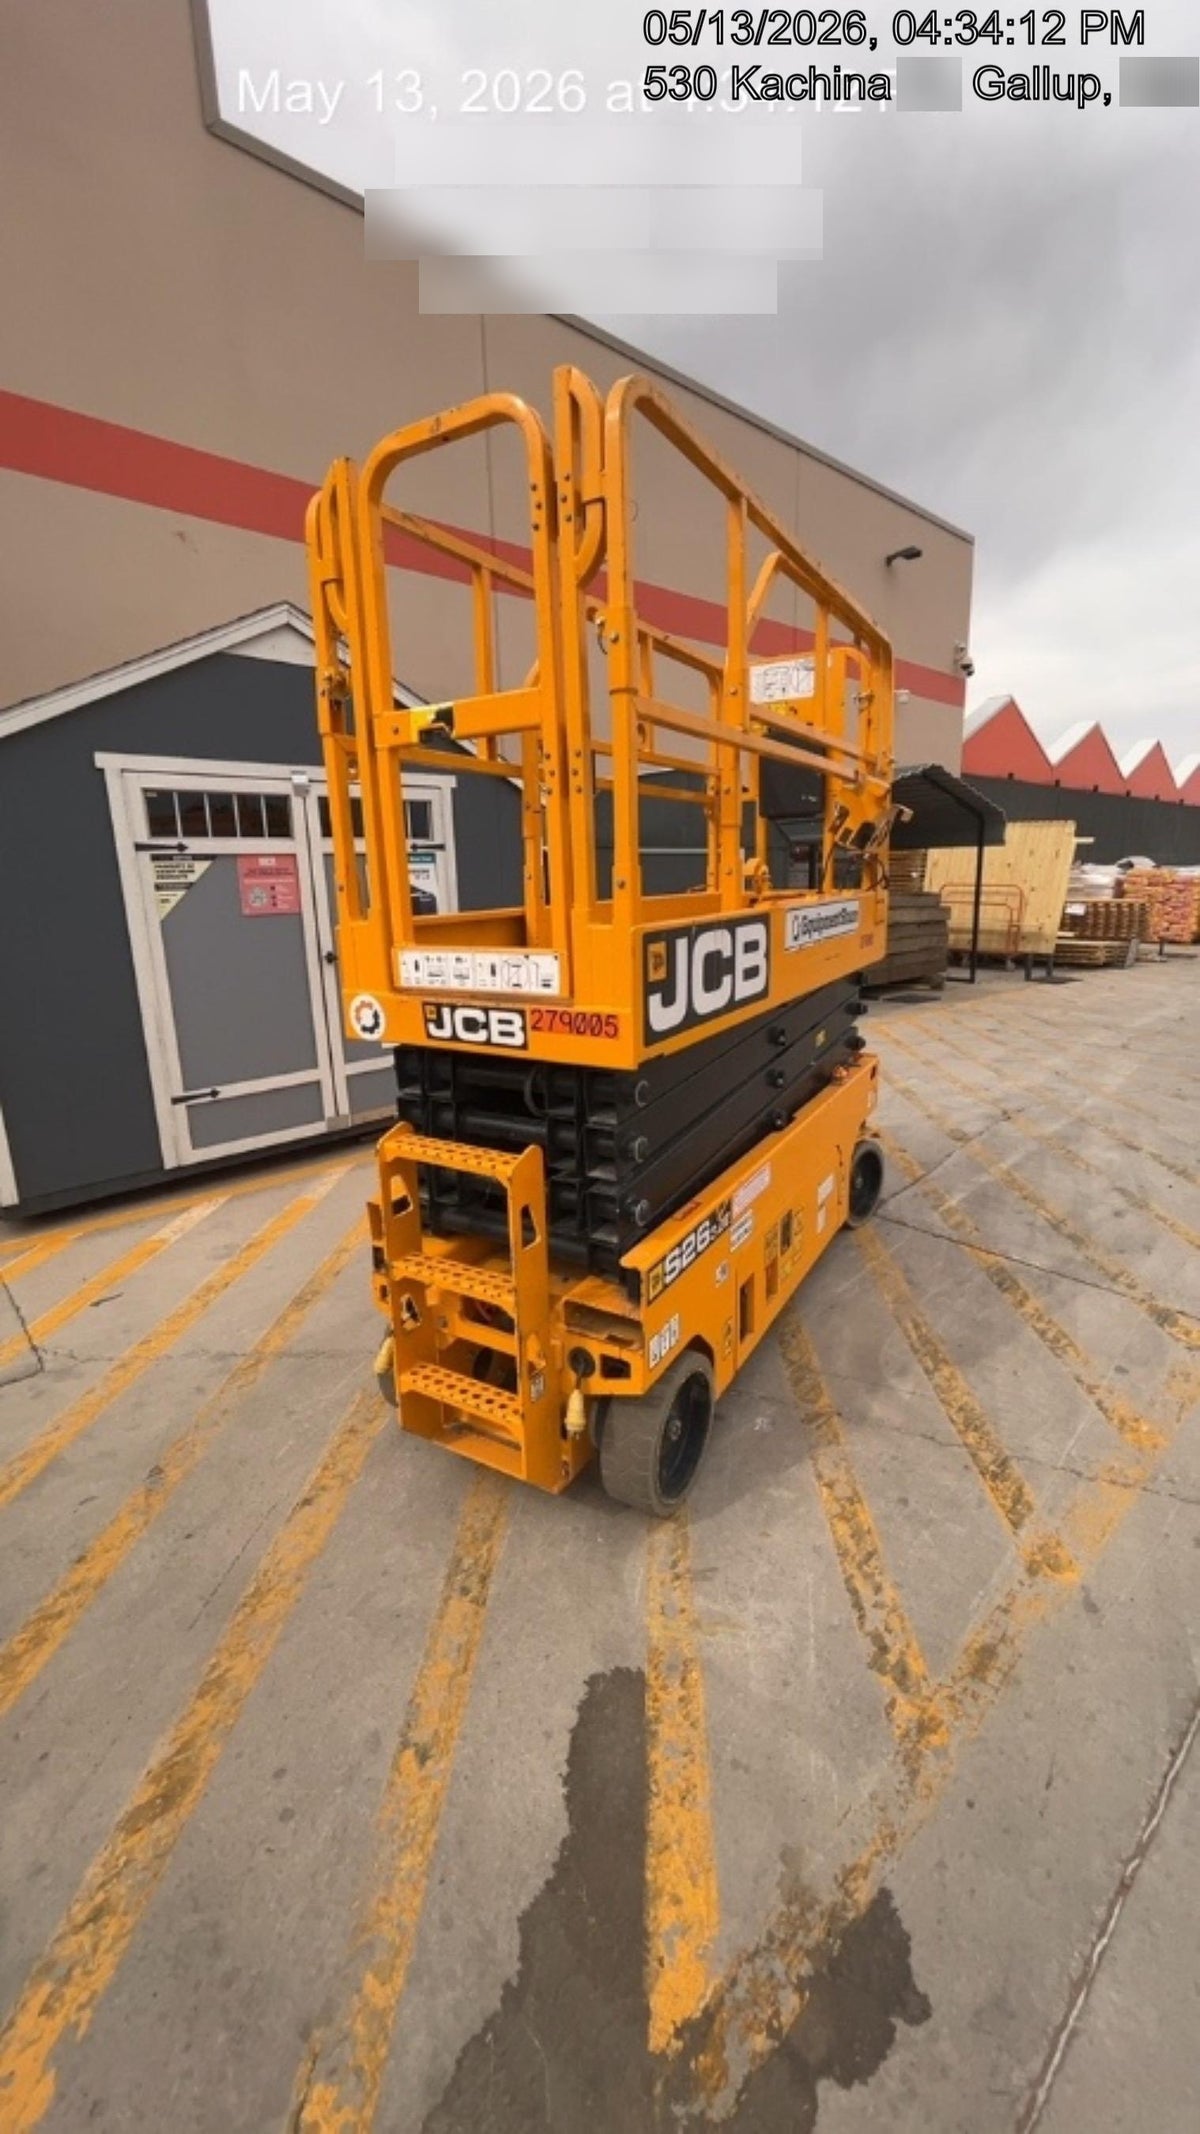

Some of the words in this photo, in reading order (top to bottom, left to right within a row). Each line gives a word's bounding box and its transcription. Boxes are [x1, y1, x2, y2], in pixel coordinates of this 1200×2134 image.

[649, 922, 767, 1032] JCB
[427, 1006, 525, 1047] JCB
[531, 1009, 618, 1039] 279005
